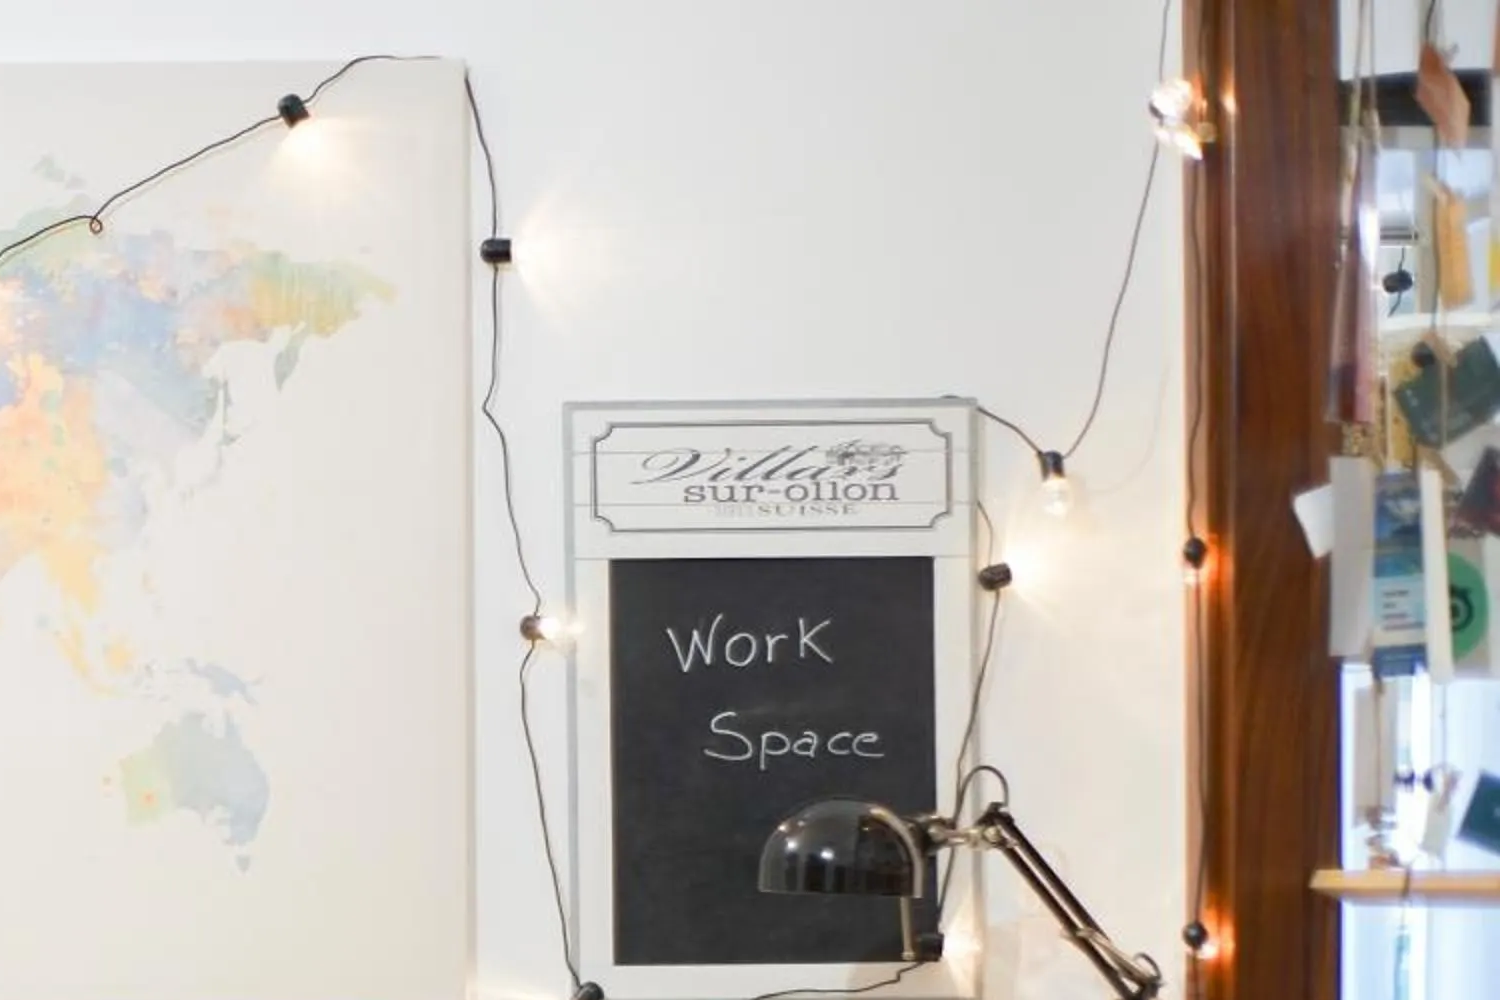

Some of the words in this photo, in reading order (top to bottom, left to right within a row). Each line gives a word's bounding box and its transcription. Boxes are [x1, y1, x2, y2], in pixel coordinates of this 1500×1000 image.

[683, 481, 900, 503] sur-ollon
[757, 504, 859, 516] SUISSE
[703, 711, 885, 770] Space
